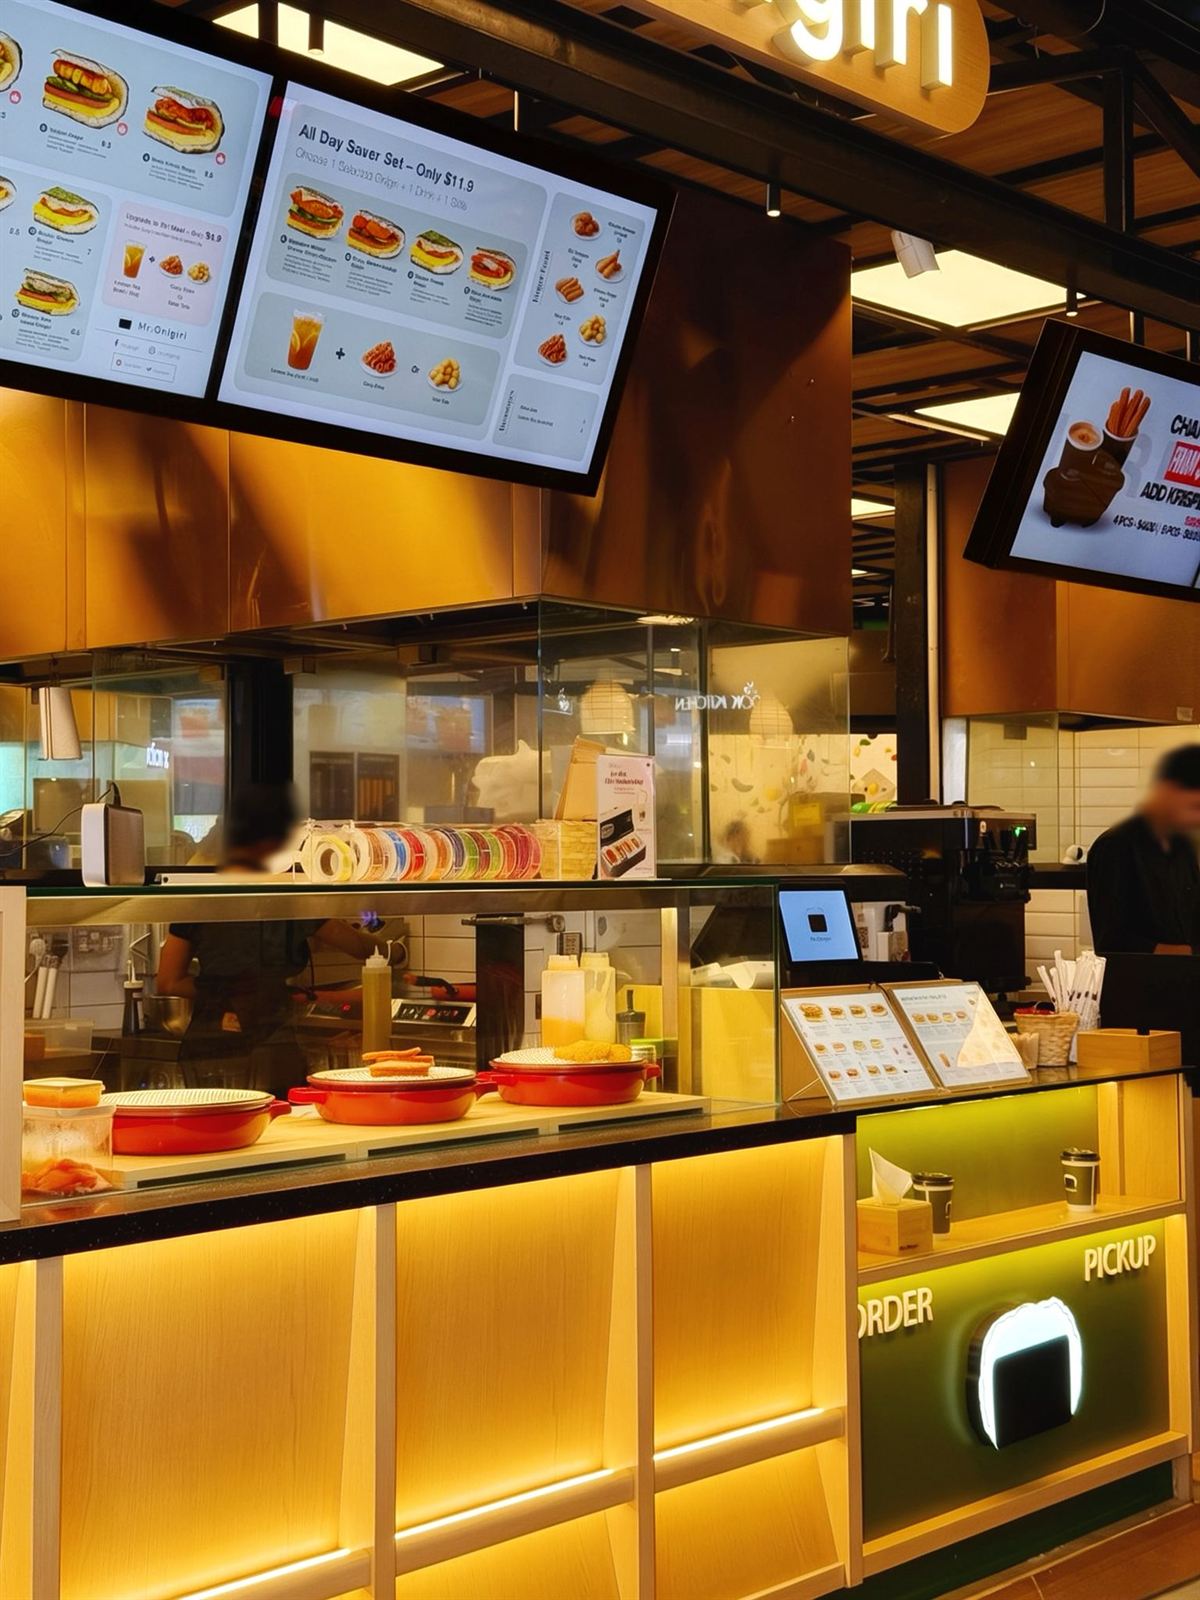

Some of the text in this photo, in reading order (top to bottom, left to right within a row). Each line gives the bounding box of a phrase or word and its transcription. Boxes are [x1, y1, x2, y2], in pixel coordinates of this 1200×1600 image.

[299, 124, 316, 141] All
[319, 130, 344, 152] Day
[346, 139, 380, 162] Saver
[383, 152, 404, 170] Set
[416, 163, 443, 185] Only
[444, 172, 475, 193] $11.9
[1140, 481, 1168, 502] ADD
[1085, 1234, 1156, 1282] PICKUP
